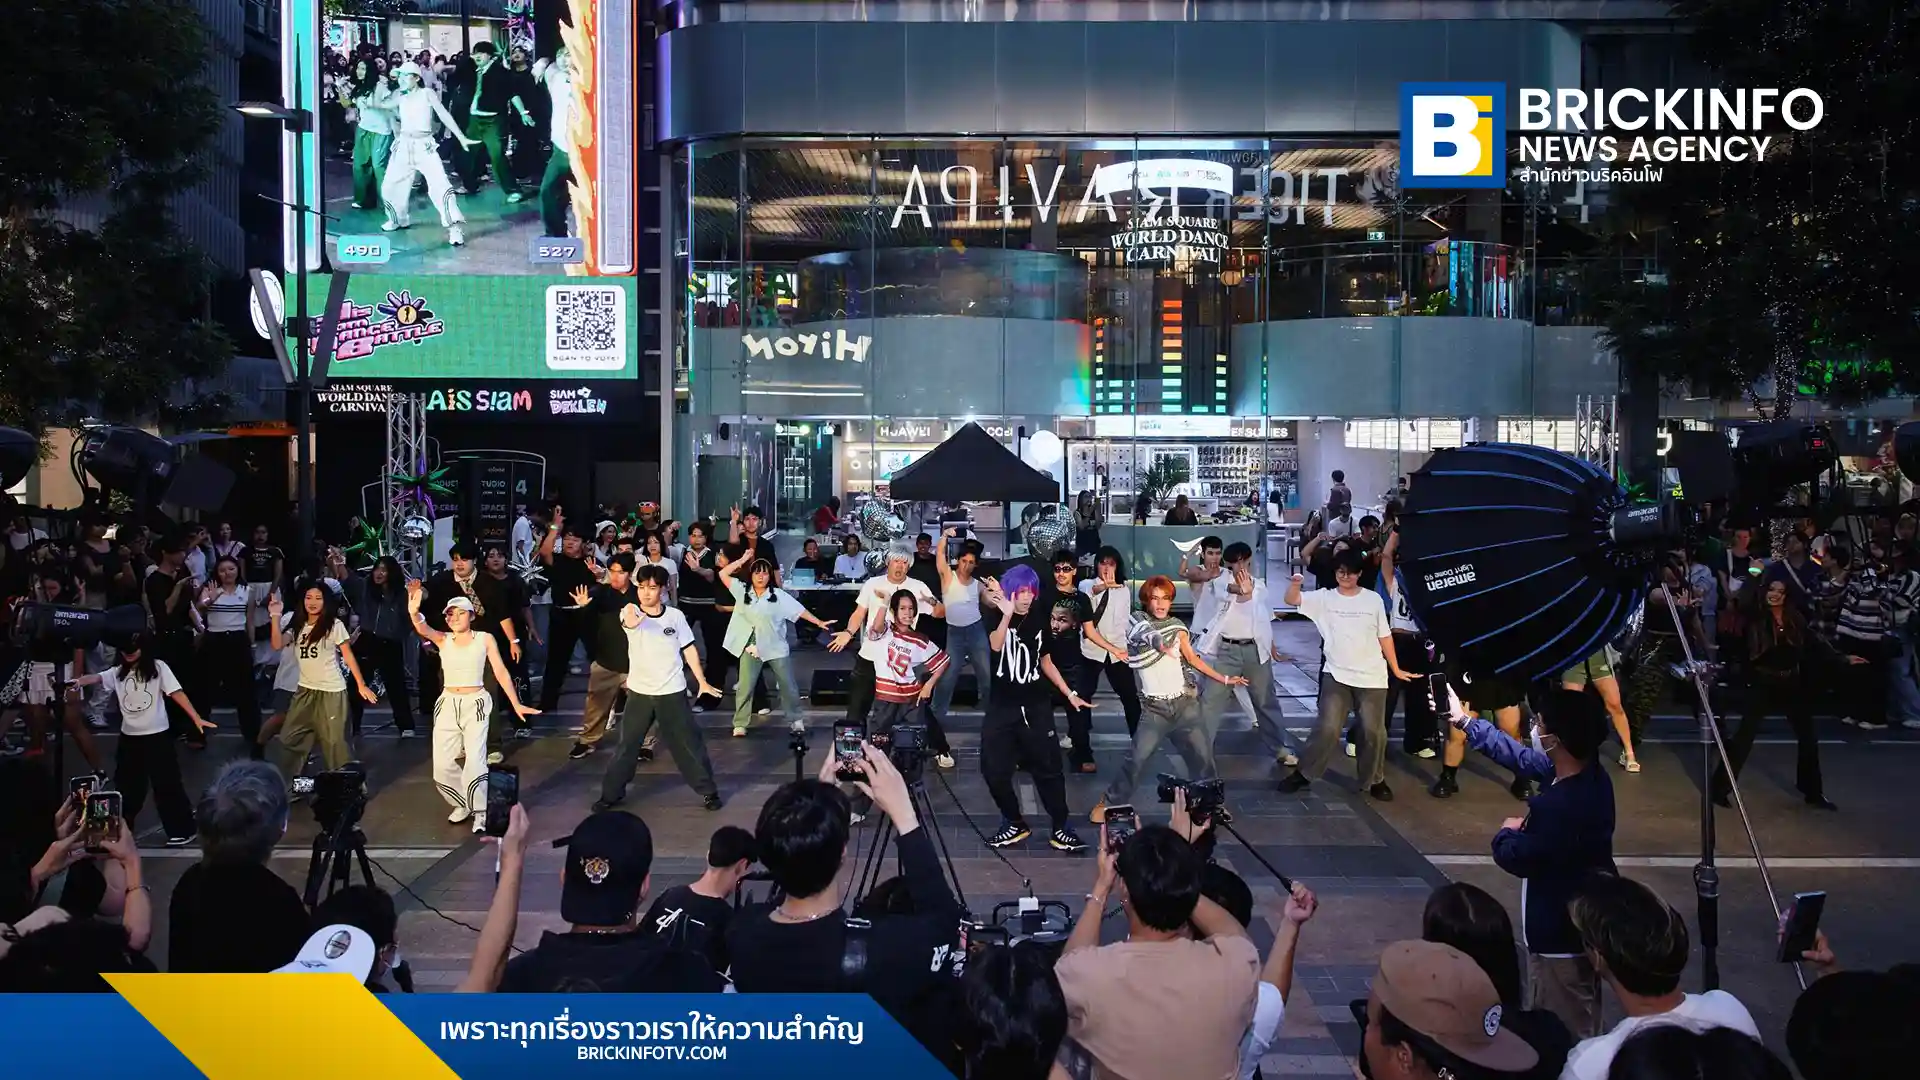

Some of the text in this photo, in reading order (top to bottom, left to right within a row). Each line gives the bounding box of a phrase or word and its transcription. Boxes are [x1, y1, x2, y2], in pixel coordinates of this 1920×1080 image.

[1126, 216, 1219, 230] SIAM SQUARE
[1111, 228, 1230, 250] WORLD DANCE
[539, 246, 577, 258] 527
[1126, 244, 1220, 263] CARNIVAL
[355, 384, 394, 392] SQUARE
[317, 392, 363, 402] WORLD
[550, 389, 576, 399] SIAM
[329, 402, 387, 413] CARNIVA
[880, 426, 932, 437] HUAWEI
[1628, 506, 1659, 518] amaran
[1455, 563, 1474, 574] Light
[1426, 571, 1476, 592] amaran
[54, 610, 89, 620] amaran
[300, 646, 318, 659] HS
